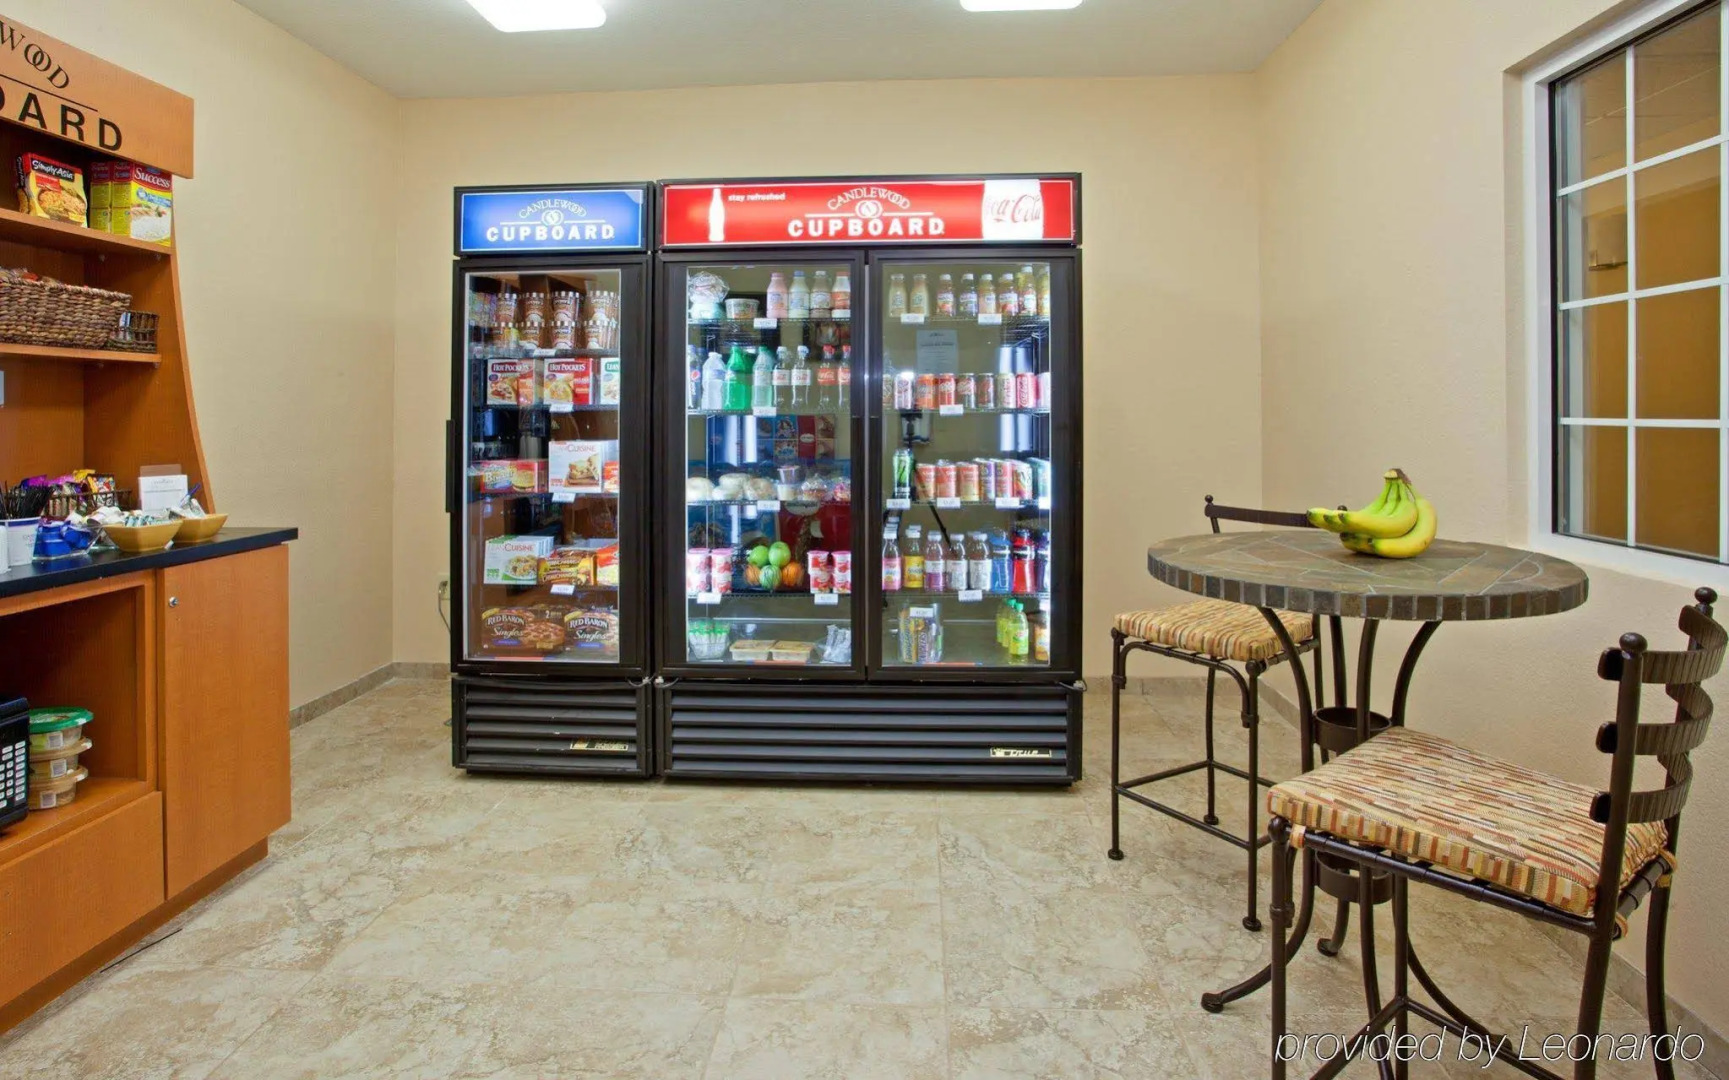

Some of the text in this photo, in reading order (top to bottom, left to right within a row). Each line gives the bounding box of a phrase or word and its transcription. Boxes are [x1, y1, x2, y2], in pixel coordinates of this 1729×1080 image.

[0, 85, 122, 151] ARD
[32, 160, 58, 175] Simply
[135, 167, 171, 189] Success
[728, 192, 786, 202] stay refreshed
[827, 187, 911, 210] CANDLEWOOD
[518, 199, 587, 220] CANDLEWOOD
[486, 224, 615, 242] CUPBOARD
[787, 217, 945, 237] CUPBOARD
[504, 542, 534, 552] CUISINE
[487, 614, 525, 625] RED BARON
[569, 618, 584, 629] RED
